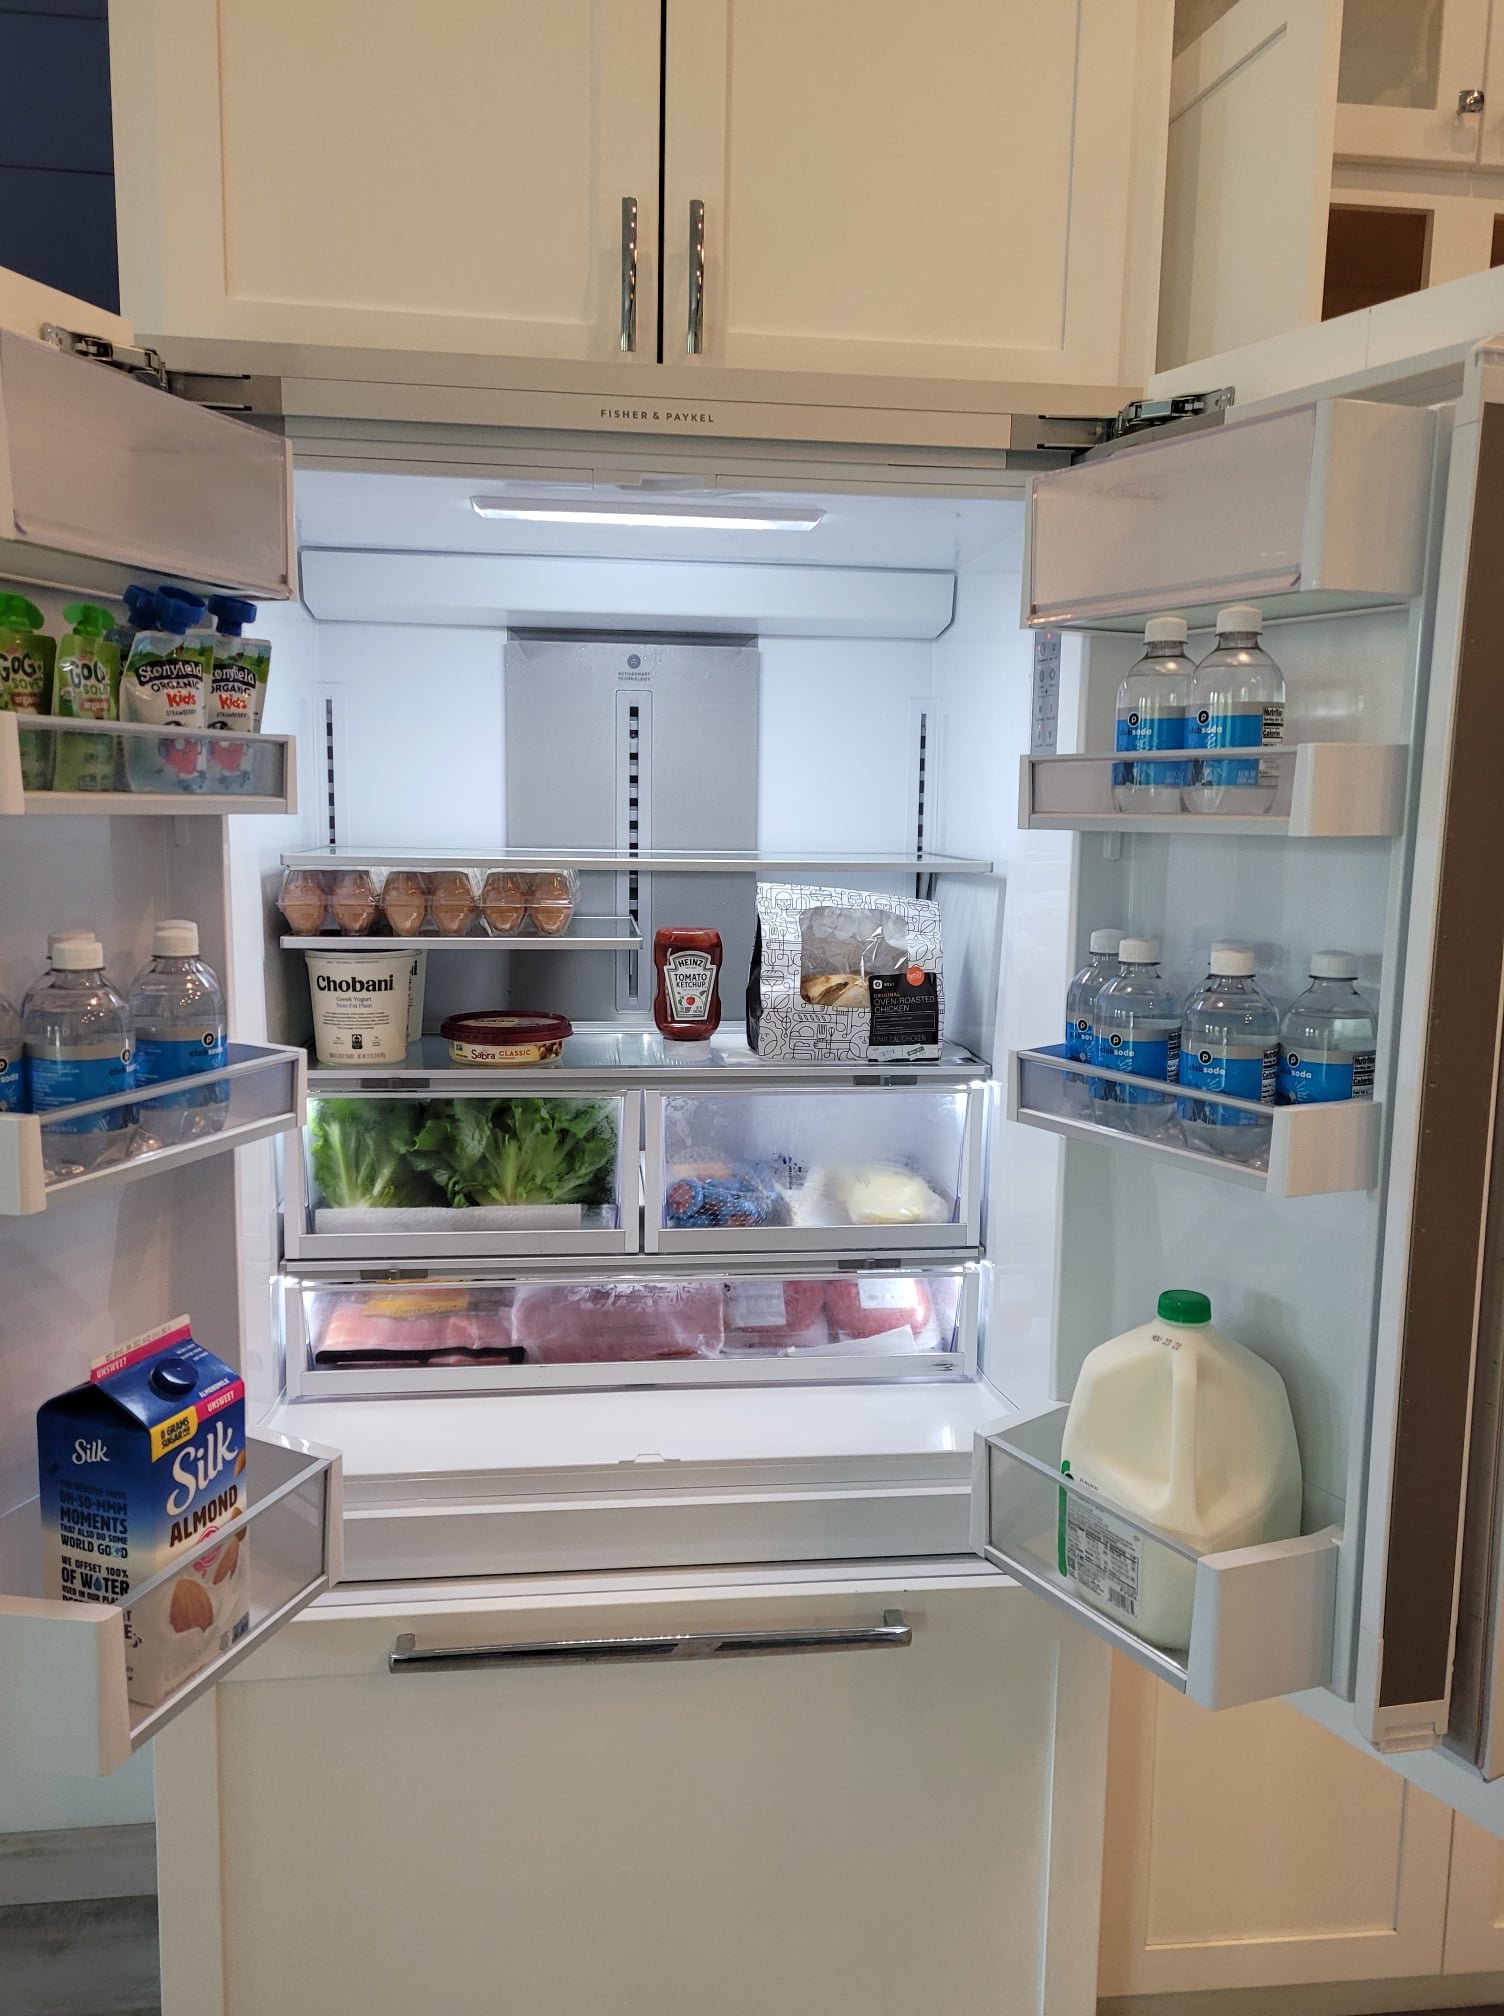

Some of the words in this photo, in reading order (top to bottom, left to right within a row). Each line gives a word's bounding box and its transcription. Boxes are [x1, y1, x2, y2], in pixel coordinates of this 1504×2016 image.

[600, 409, 648, 420] FISHER
[652, 411, 660, 420] &
[666, 412, 714, 423] PAYKEL
[138, 661, 202, 681] Stonyfield
[212, 665, 255, 685] tonyfield
[151, 680, 200, 692] ORGANIC
[166, 691, 196, 708] Kids
[218, 694, 247, 710] Kids
[677, 958, 704, 968] HEINZ
[316, 974, 394, 993] Chobani
[674, 973, 707, 981] TOMATO
[873, 995, 935, 1006] OVEN-ROASTED
[874, 1005, 910, 1013] CHICKEN
[471, 1049, 496, 1060] Sabra
[96, 1356, 127, 1378] UNSWEET
[198, 1377, 230, 1398] ALMONDMILK
[207, 1390, 234, 1412] UNSWEET
[160, 1430, 165, 1439] 0
[167, 1416, 189, 1436] GRAMS
[161, 1431, 183, 1448] SUGAR
[71, 1439, 111, 1465] Silk
[166, 1420, 239, 1517] Silk
[60, 1489, 128, 1516] OH-SO-MMM
[60, 1506, 128, 1535] MOMENTS
[169, 1484, 238, 1548] ALMOND
[60, 1523, 76, 1534] THAT
[77, 1527, 95, 1539] ALSO
[96, 1531, 106, 1541] DO
[108, 1534, 128, 1545] SOME
[61, 1534, 94, 1553] WORLD
[61, 1555, 72, 1567] WE
[75, 1559, 102, 1574] OFFSET
[105, 1566, 129, 1578] 100%
[61, 1566, 77, 1585] OF
[80, 1571, 130, 1596] WTER
[62, 1584, 77, 1596] USED
[78, 1589, 86, 1598] IN
[87, 1591, 101, 1602] OUR
[102, 1595, 119, 1605] PLA
